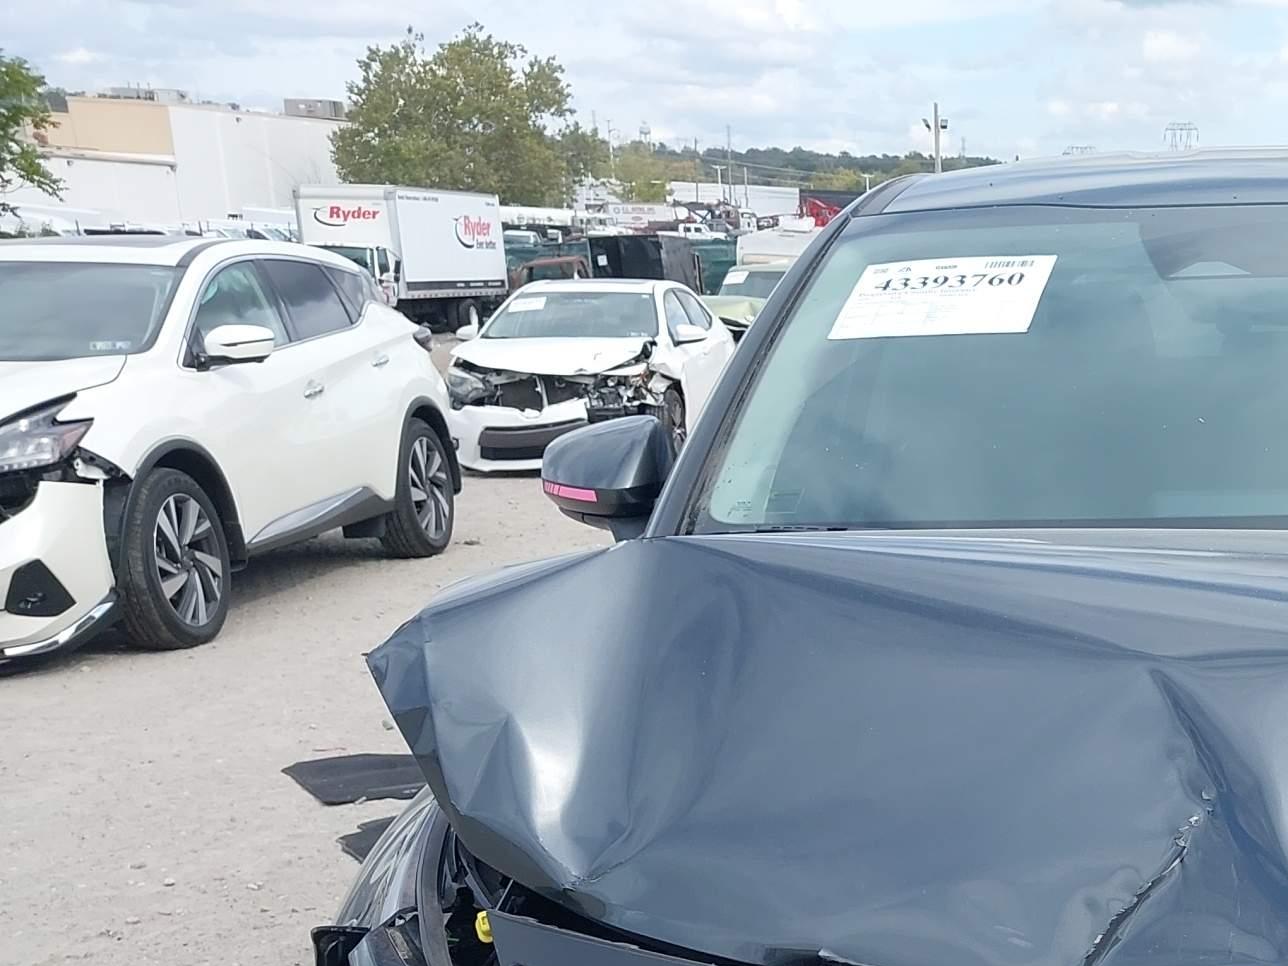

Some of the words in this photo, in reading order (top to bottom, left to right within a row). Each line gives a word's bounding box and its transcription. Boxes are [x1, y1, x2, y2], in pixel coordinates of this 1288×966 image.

[329, 206, 381, 222] Ryder
[463, 215, 491, 241] Ryder
[873, 272, 1026, 292] 43393760
